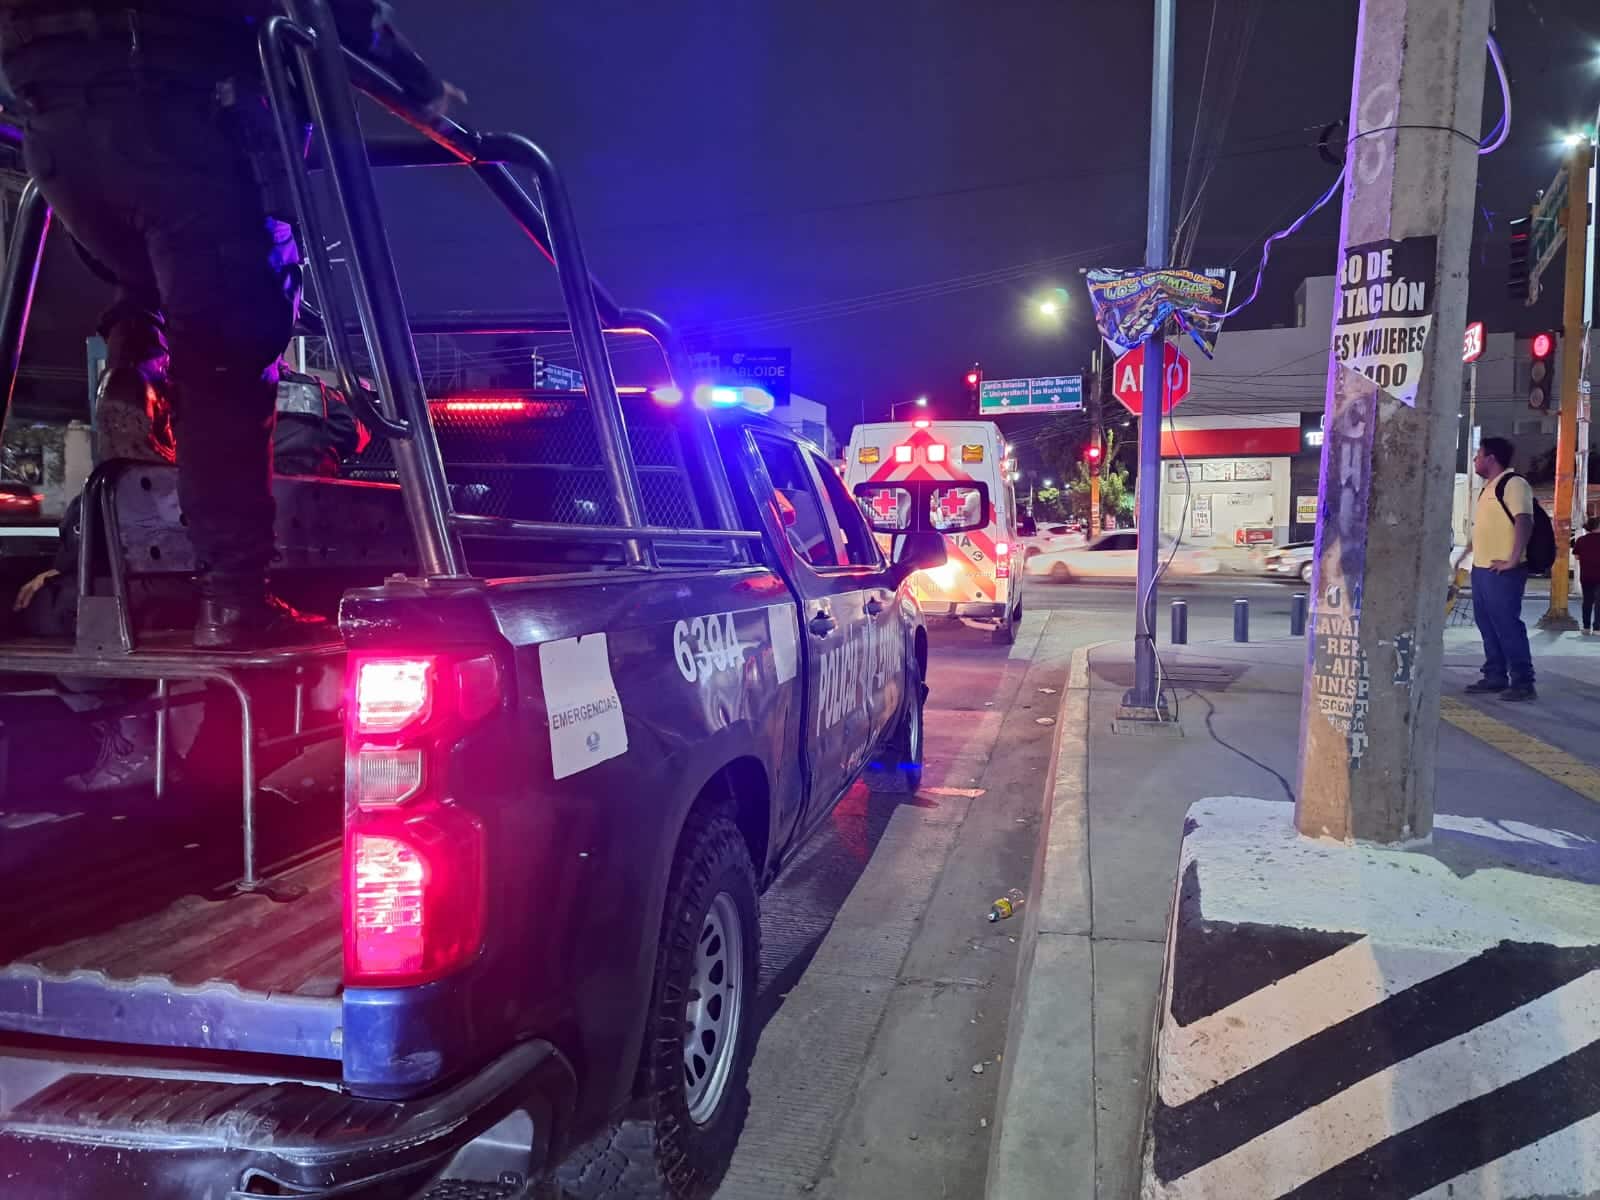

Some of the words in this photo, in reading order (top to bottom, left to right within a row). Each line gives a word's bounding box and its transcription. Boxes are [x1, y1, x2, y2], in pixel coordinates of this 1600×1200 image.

[1367, 249, 1392, 279] DE
[1352, 334, 1361, 357] Y
[1362, 325, 1425, 356] MUJERES
[1055, 378, 1080, 386] Banorte
[552, 696, 618, 729] EMERGENCIAS
